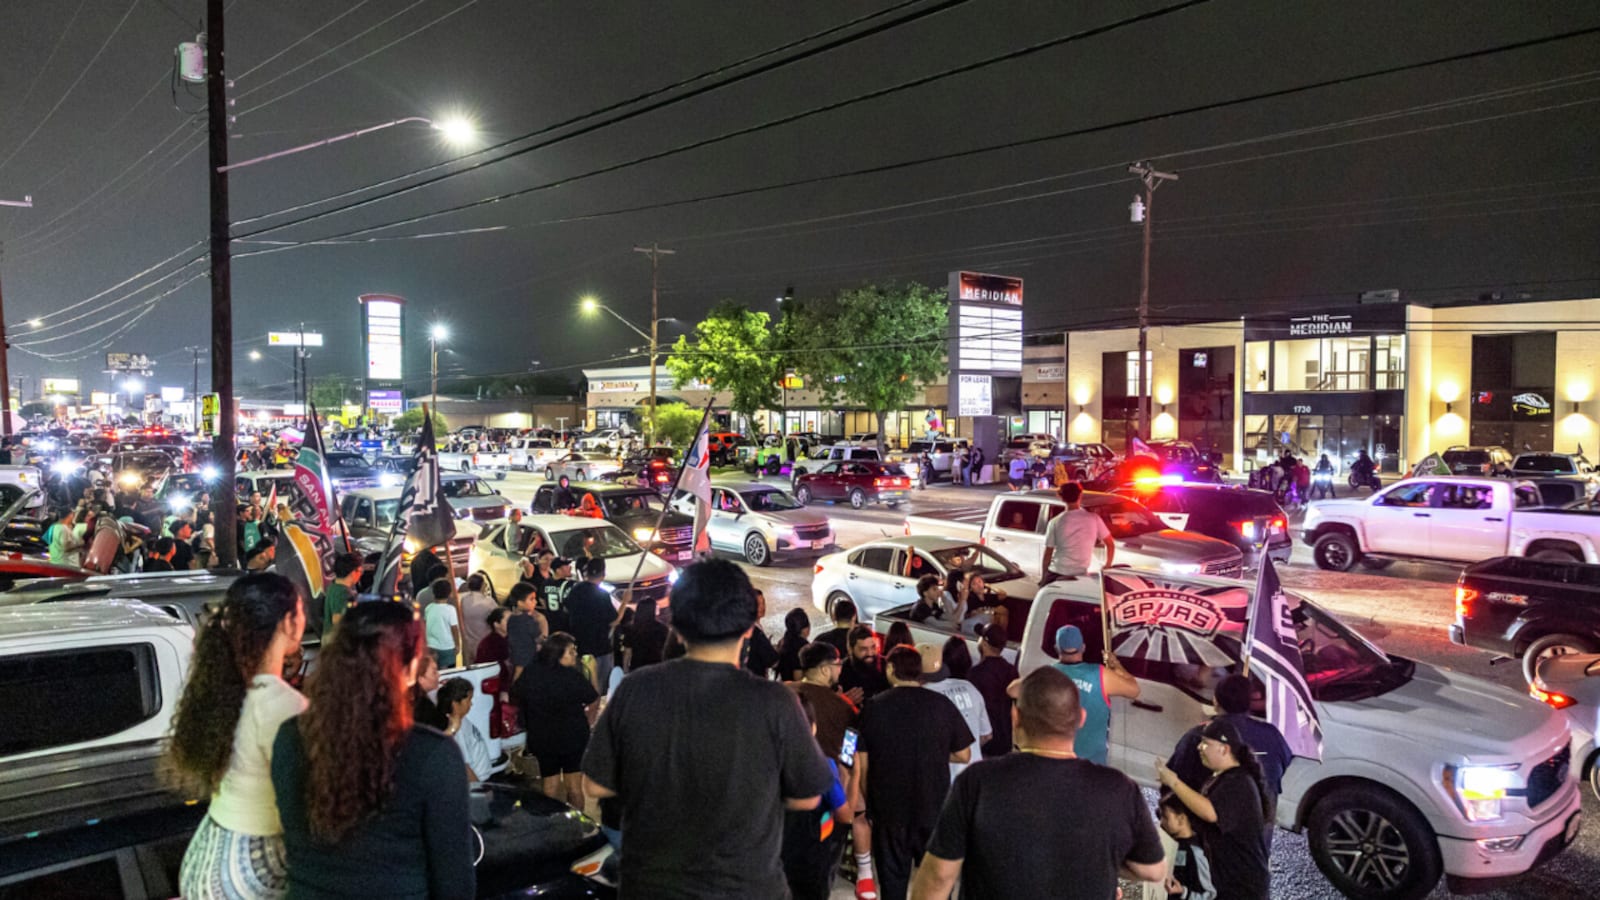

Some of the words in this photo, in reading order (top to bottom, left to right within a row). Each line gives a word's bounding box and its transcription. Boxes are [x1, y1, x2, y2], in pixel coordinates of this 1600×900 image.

[965, 287, 1019, 304] MERIDIAN
[1290, 321, 1352, 335] MERIDIAN
[973, 375, 989, 383] LEASE
[1293, 405, 1311, 413] 1730
[299, 474, 321, 504] SAN
[548, 593, 559, 611] 5
[1127, 592, 1150, 601] SAN
[1155, 592, 1210, 608] ANTONIO
[1123, 602, 1210, 628] SPURS
